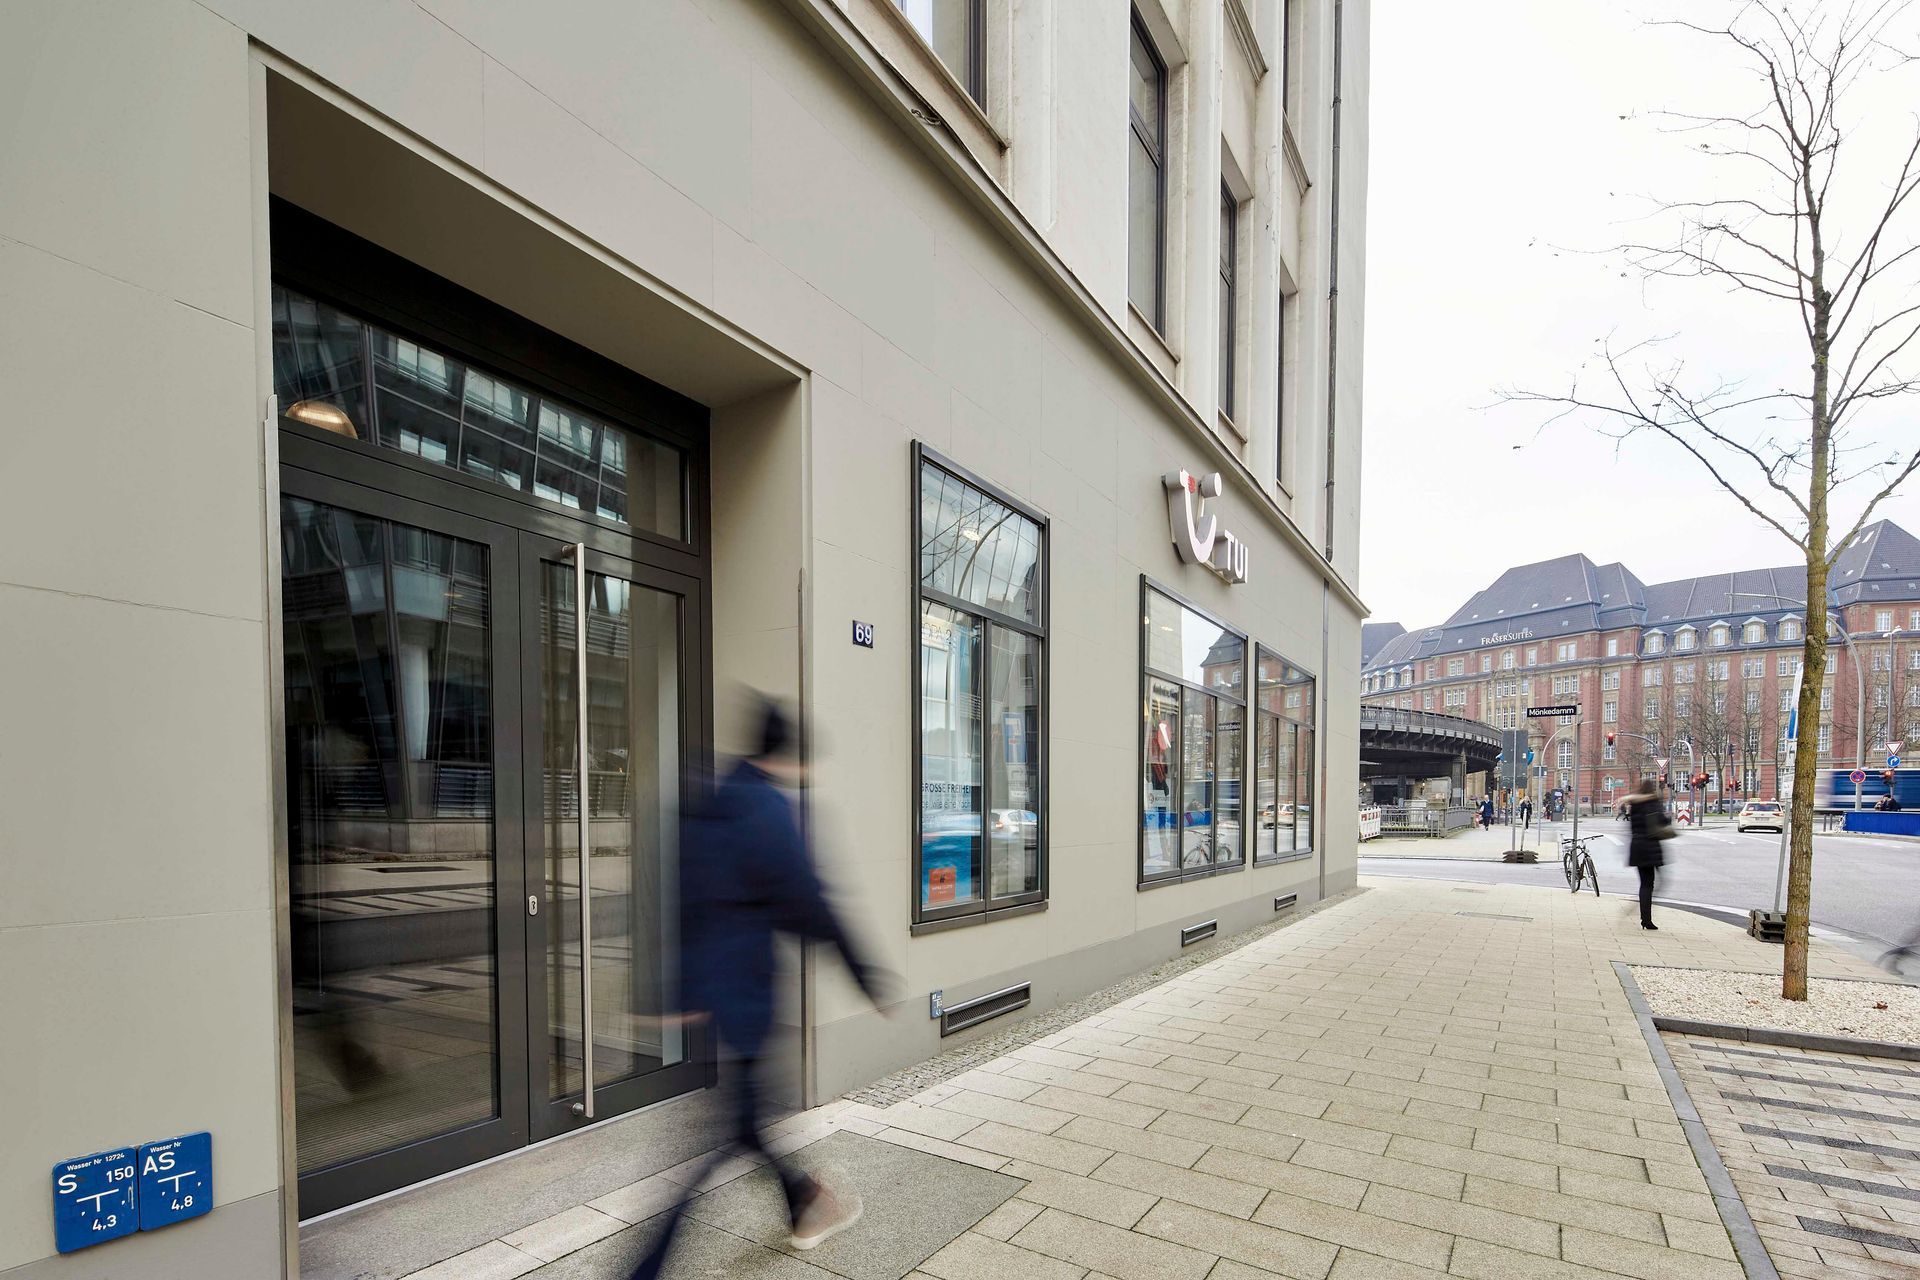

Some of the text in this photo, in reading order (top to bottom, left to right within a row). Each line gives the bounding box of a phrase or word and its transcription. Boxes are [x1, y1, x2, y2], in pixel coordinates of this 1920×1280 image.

[1224, 529, 1248, 584] TUI
[856, 623, 872, 645] 69
[1481, 630, 1533, 645] FRASER SUITES
[1528, 707, 1575, 716] Mönkedamm
[150, 1144, 172, 1153] Wasser
[67, 1161, 92, 1171] Wasser
[143, 1151, 176, 1176] AS
[106, 1165, 135, 1183] 150
[58, 1173, 78, 1194] S
[171, 1195, 193, 1210] 4,8
[92, 1214, 117, 1231] 4,3
